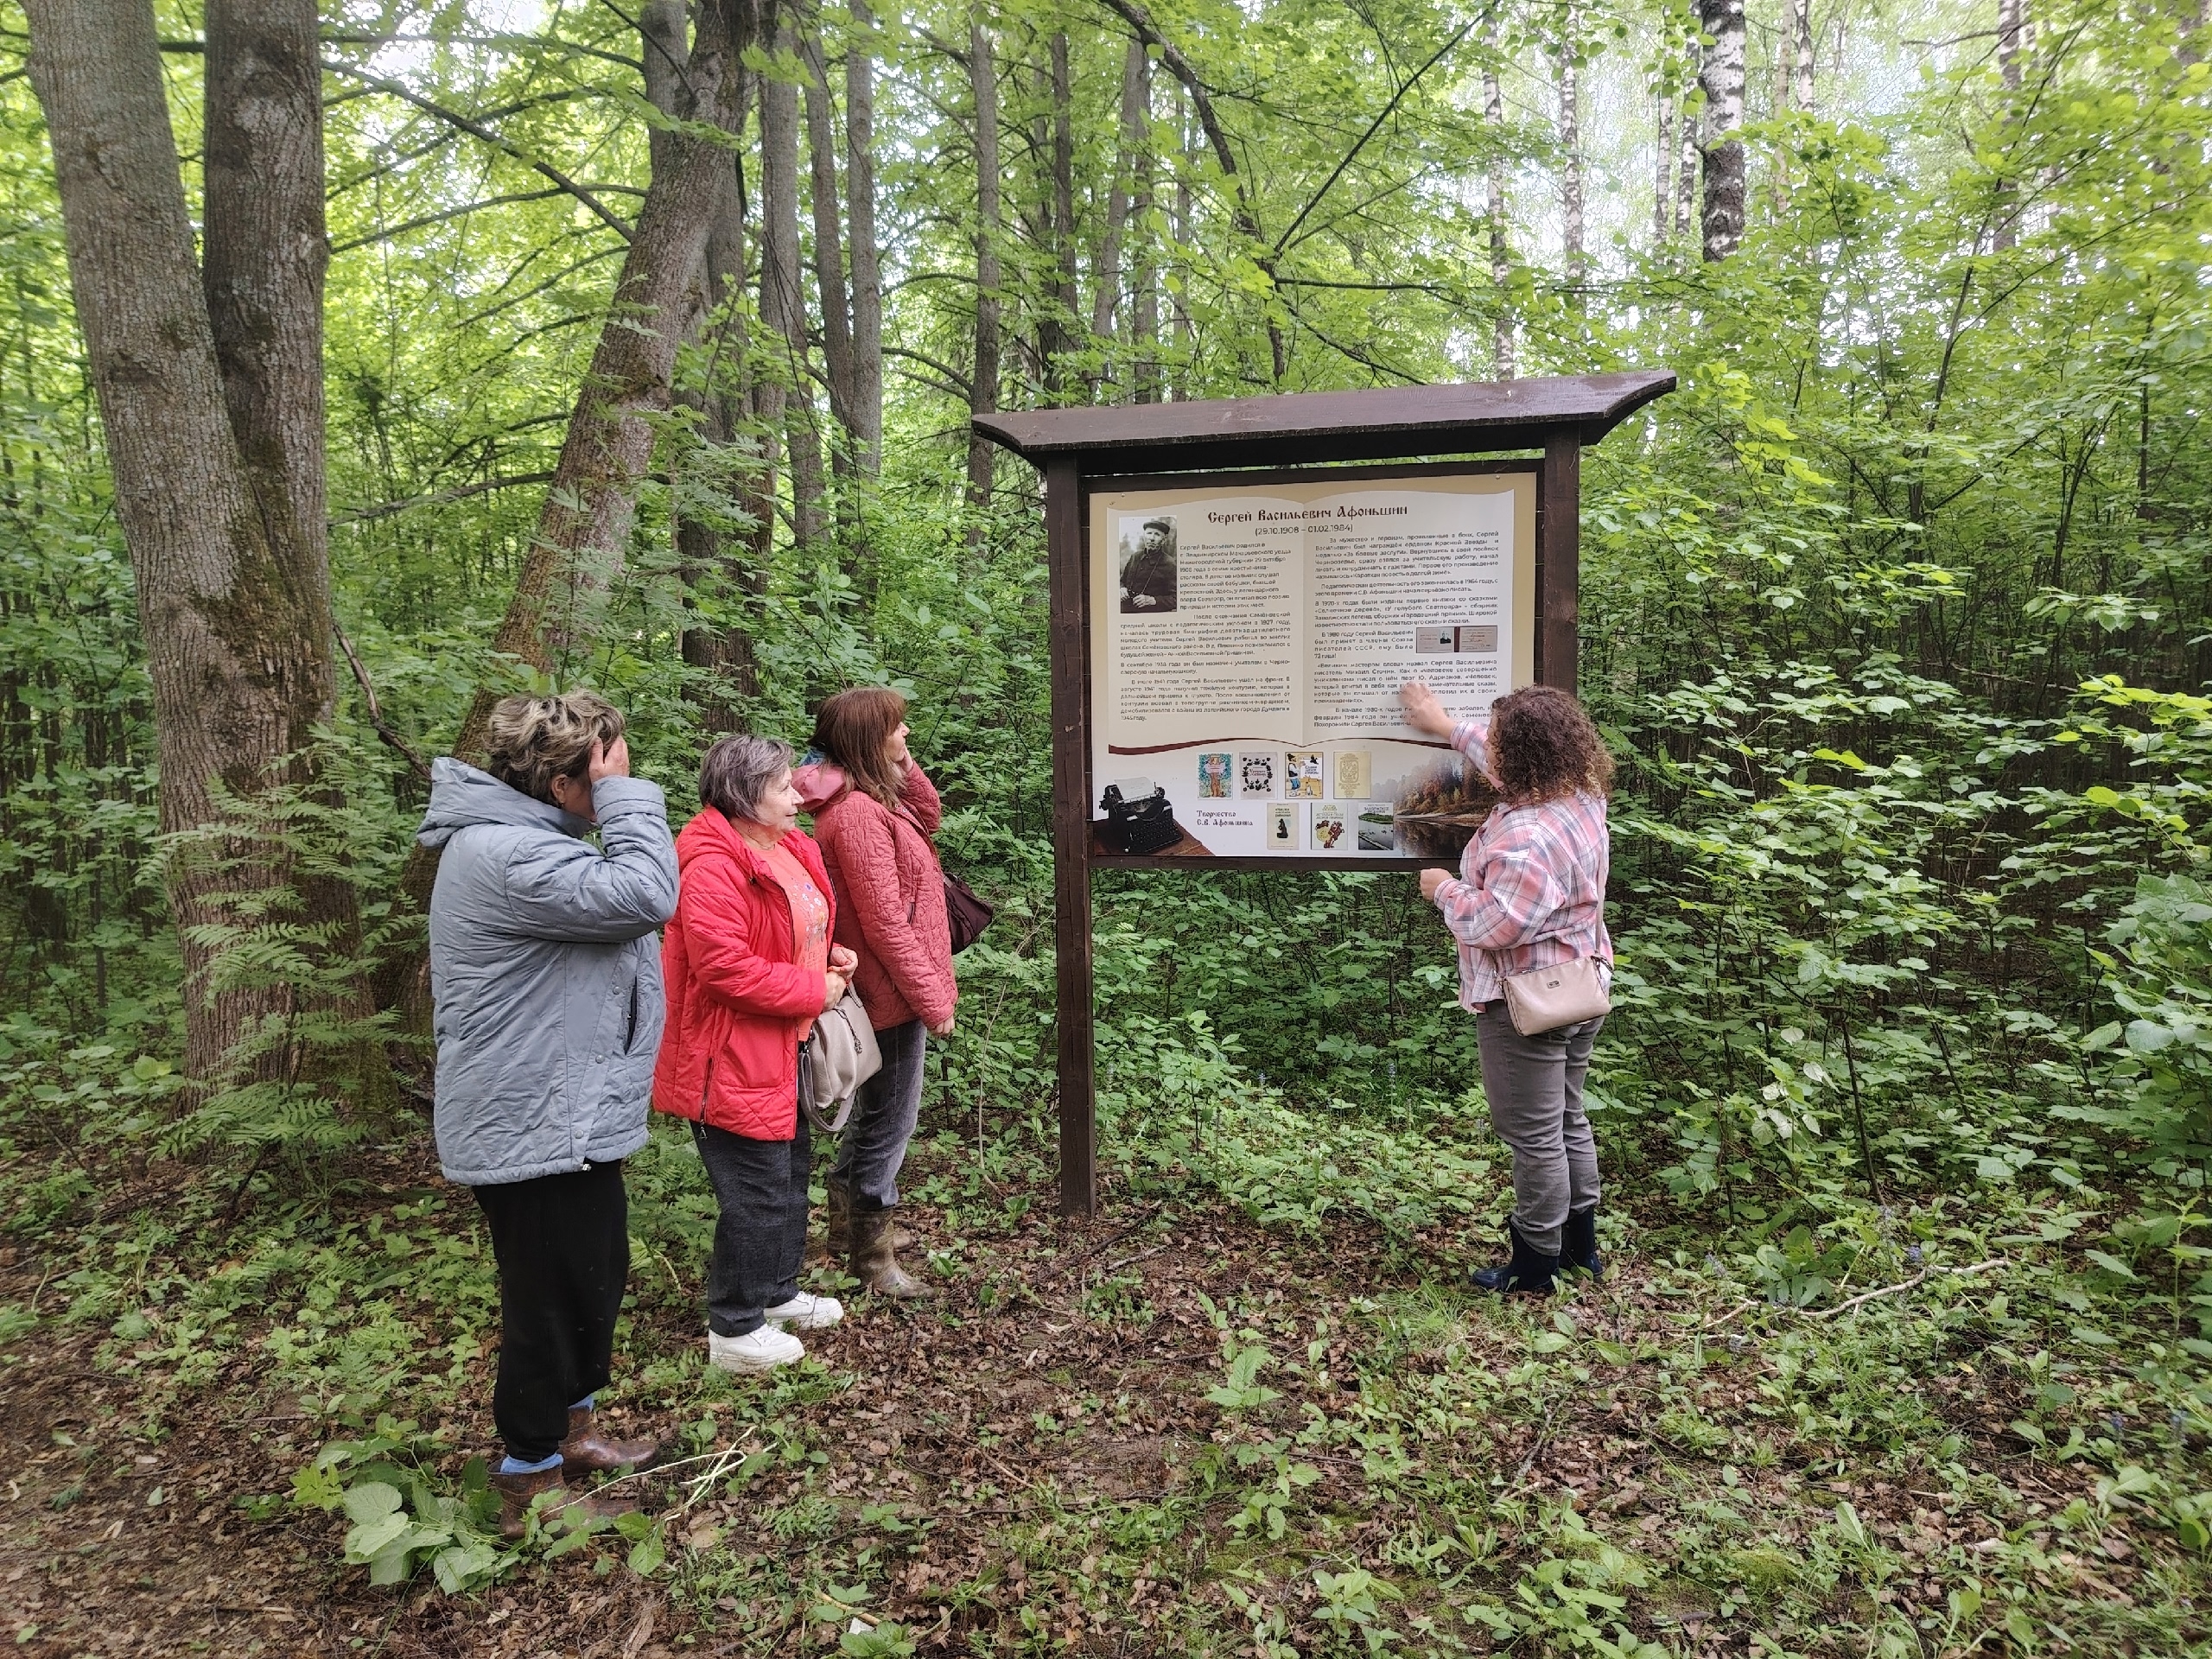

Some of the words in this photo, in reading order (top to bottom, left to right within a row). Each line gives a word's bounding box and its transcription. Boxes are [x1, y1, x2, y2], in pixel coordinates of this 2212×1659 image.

[1208, 512, 1252, 525] Сергей
[1258, 508, 1332, 522] Васильевич
[1337, 505, 1408, 521] Афоньшин
[1255, 526, 1300, 537] (29.10.1908
[1307, 524, 1354, 534] 01.02.1984)
[1196, 809, 1236, 818] Творчество
[1213, 818, 1254, 827] Афоньшина
